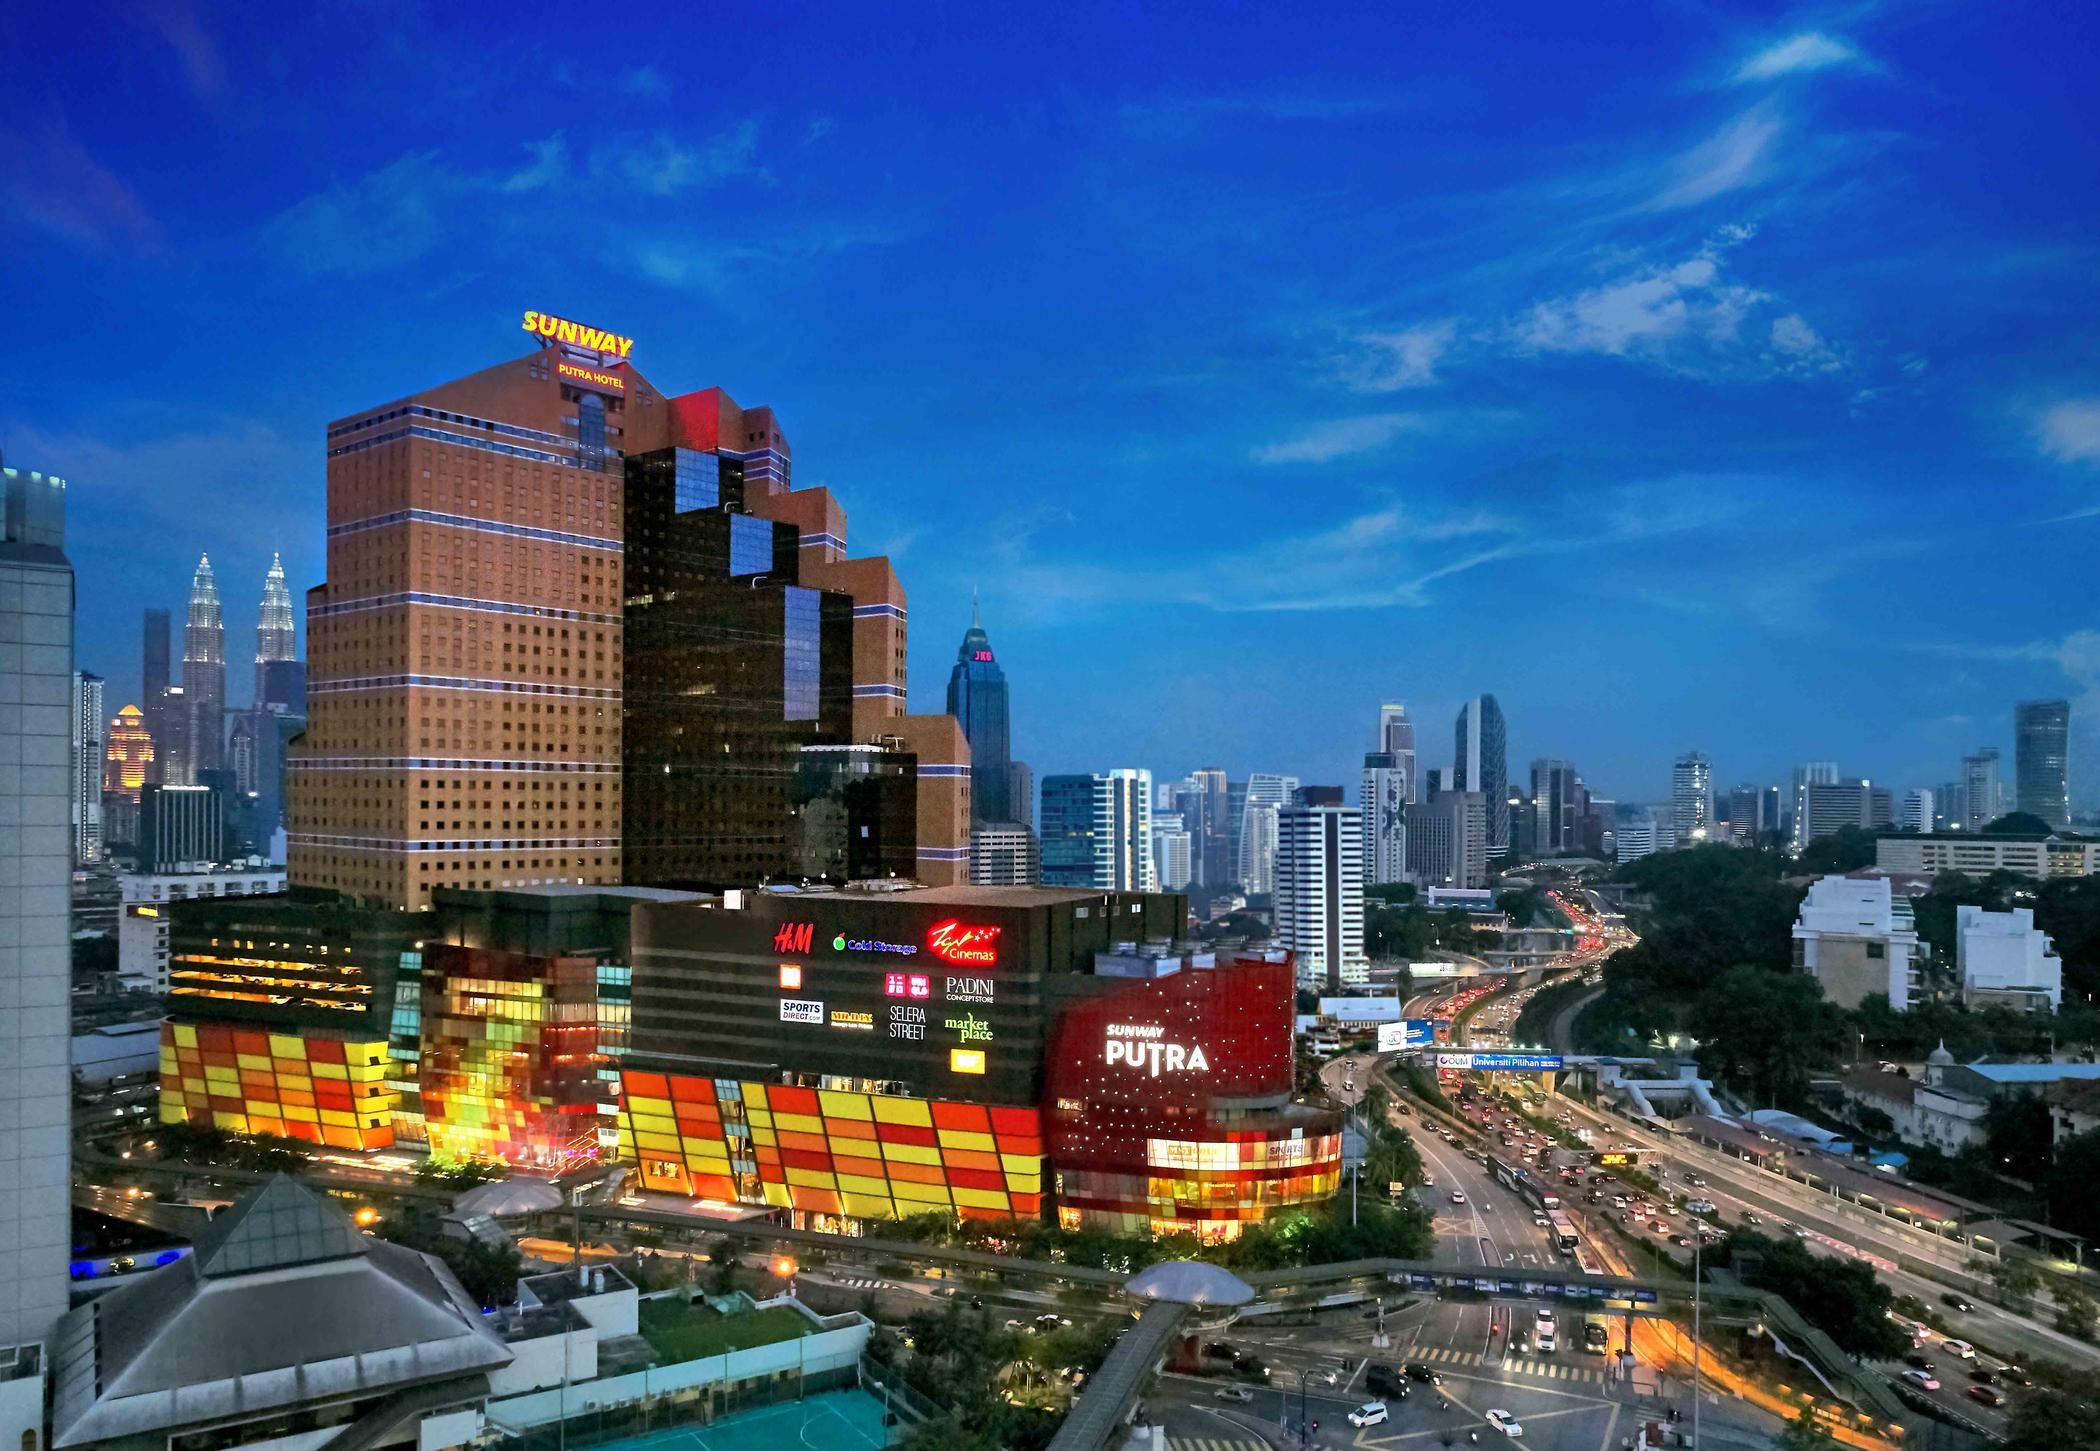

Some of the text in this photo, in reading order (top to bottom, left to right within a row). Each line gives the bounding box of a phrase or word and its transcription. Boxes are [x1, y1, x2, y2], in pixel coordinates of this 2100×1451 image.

[522, 311, 634, 357] SUNWAY
[559, 364, 624, 388] PUTRA HOTEL
[975, 651, 992, 661] JKG
[774, 922, 814, 954] H&M
[848, 940, 918, 955] Cold Storage
[949, 948, 994, 961] Cinemas
[946, 977, 994, 995] PADINI
[783, 1002, 820, 1013] SPORTS
[890, 1006, 926, 1023] SELERA
[945, 1012, 989, 1031] market
[890, 1023, 927, 1040] STREET
[960, 1029, 993, 1043] place
[1106, 1024, 1165, 1038] SUNWAY
[1106, 1040, 1210, 1078] PUTRA
[1472, 1057, 1511, 1066] Universiti
[1512, 1058, 1539, 1067] Pilihan
